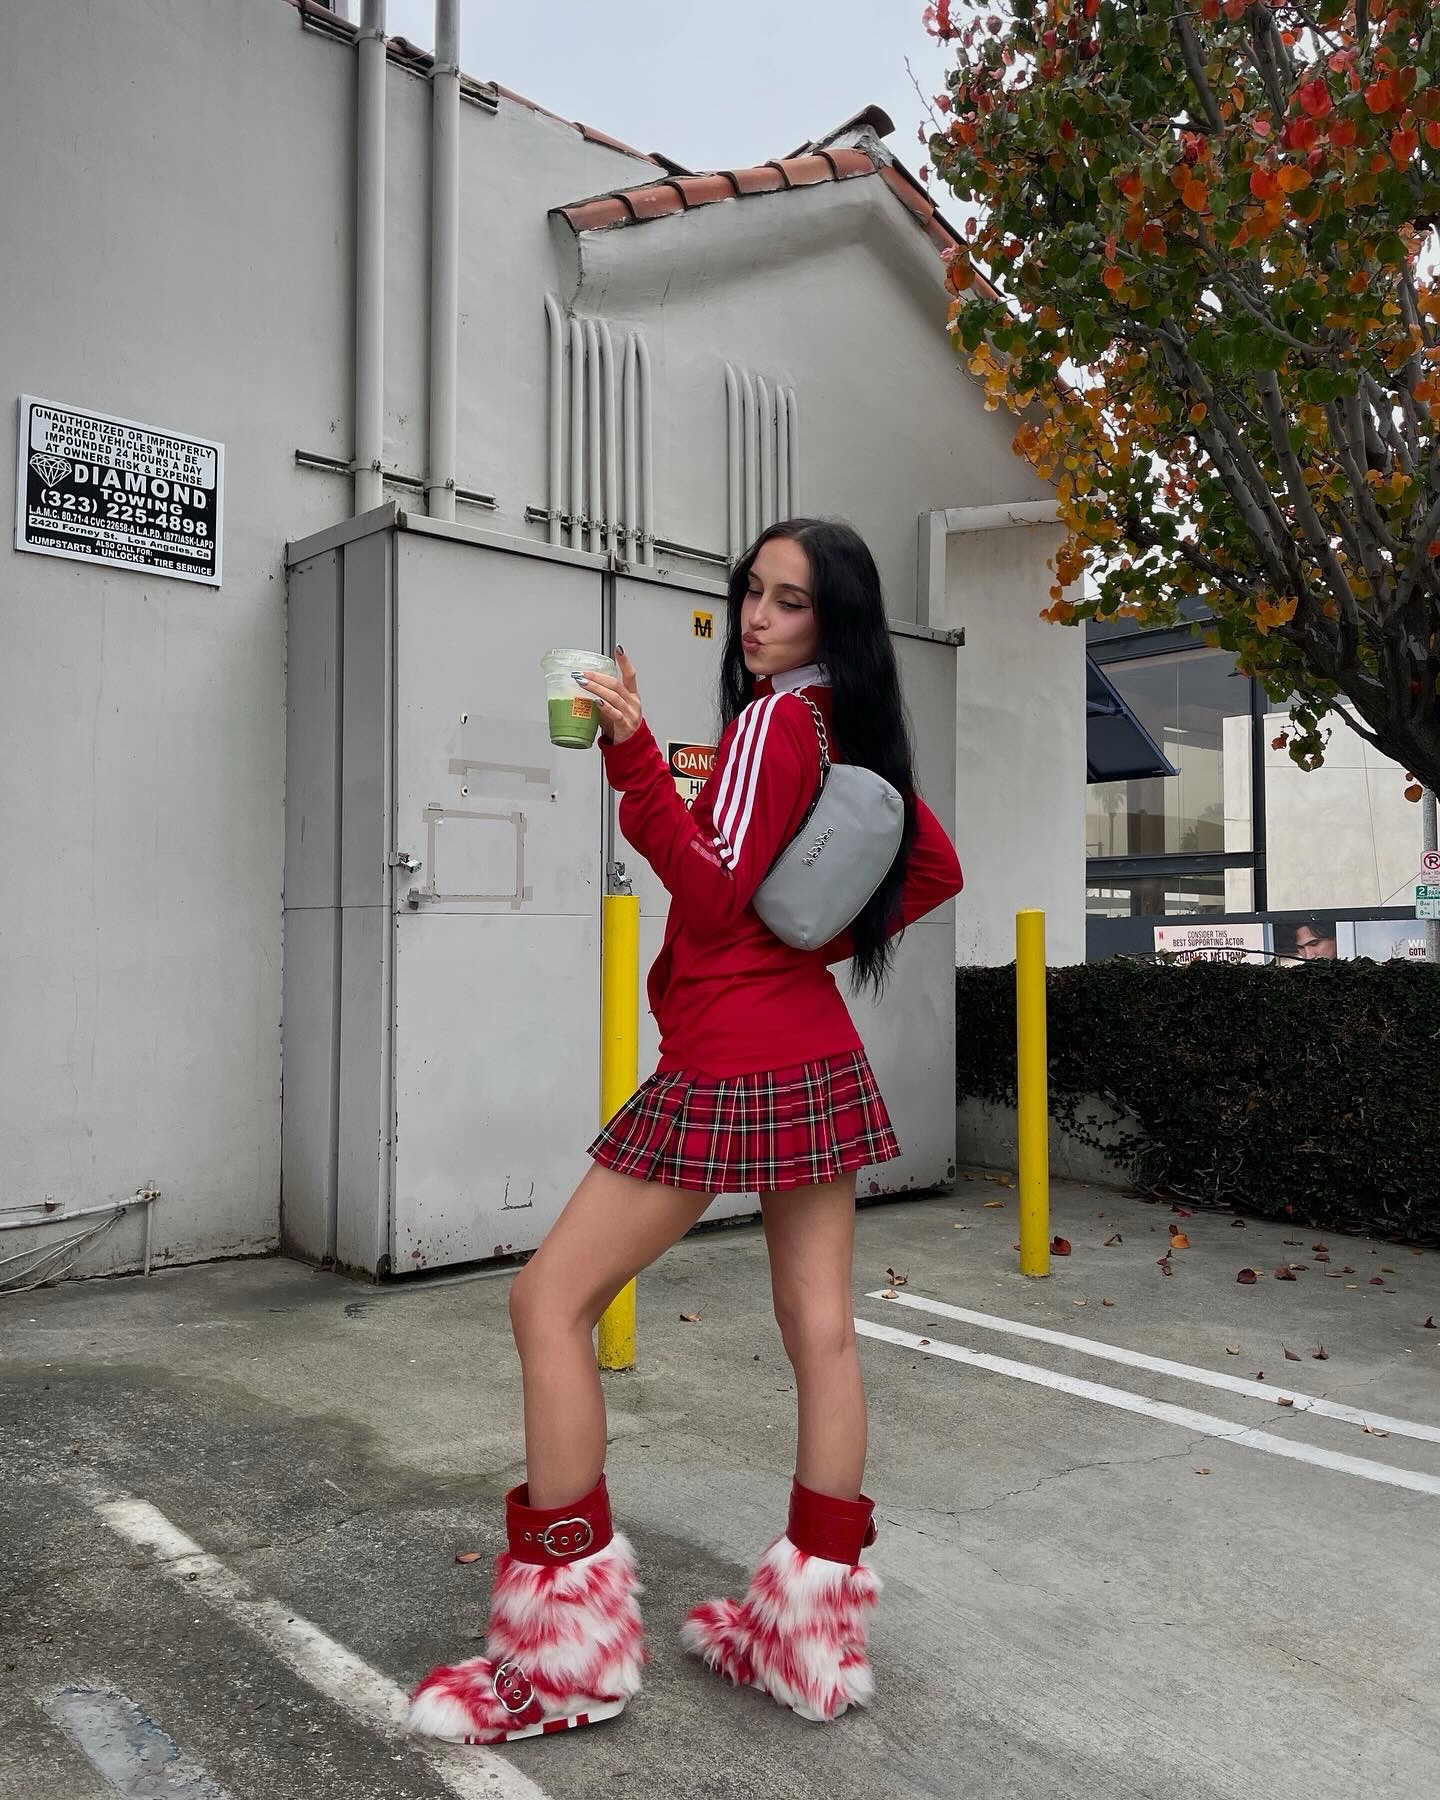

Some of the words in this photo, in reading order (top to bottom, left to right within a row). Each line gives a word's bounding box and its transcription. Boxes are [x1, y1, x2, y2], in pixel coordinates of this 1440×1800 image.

[36, 408, 124, 437] UNAUTHORIZED
[128, 431, 143, 442] OR
[147, 435, 212, 458] IMPROPERLY
[45, 431, 112, 454] IMPOUNDED
[116, 448, 128, 458] 24
[133, 452, 168, 468] HOURS
[172, 462, 179, 470] A
[183, 464, 202, 475] DAY
[52, 422, 96, 440] PARKED
[100, 434, 152, 454] VEHICLES
[156, 447, 181, 461] WILL
[185, 455, 198, 465] BE
[45, 443, 59, 453] AT
[63, 447, 110, 465] OWNERS
[114, 458, 140, 471] RISK
[144, 465, 151, 474] &
[156, 468, 202, 486] EXPENSE
[74, 463, 207, 509] DIAMOND
[99, 488, 183, 515] TOWING
[41, 489, 98, 513] (323)
[106, 503, 208, 536] 225-4898
[90, 516, 105, 528] CVC
[106, 520, 135, 534] 22658-A
[29, 535, 92, 553] JUMPSTARTS
[101, 548, 145, 563] UNLOCKS
[154, 557, 174, 569] TIRE
[176, 562, 213, 576] SERVICE
[31, 517, 59, 529] 2420
[62, 523, 100, 538] Forney
[103, 532, 118, 541] St.
[127, 536, 146, 546] Los
[149, 541, 193, 556] Angeles,
[196, 550, 209, 558] Ca
[95, 540, 115, 549] ALSO
[116, 544, 135, 553] CALL
[1418, 887, 1426, 896] 2
[1172, 939, 1186, 947] BEST
[1187, 938, 1224, 947] SUPPORTING
[1225, 937, 1245, 946] ACTOR
[1187, 930, 1214, 939] CONSIDER
[1215, 930, 1228, 938] THIS
